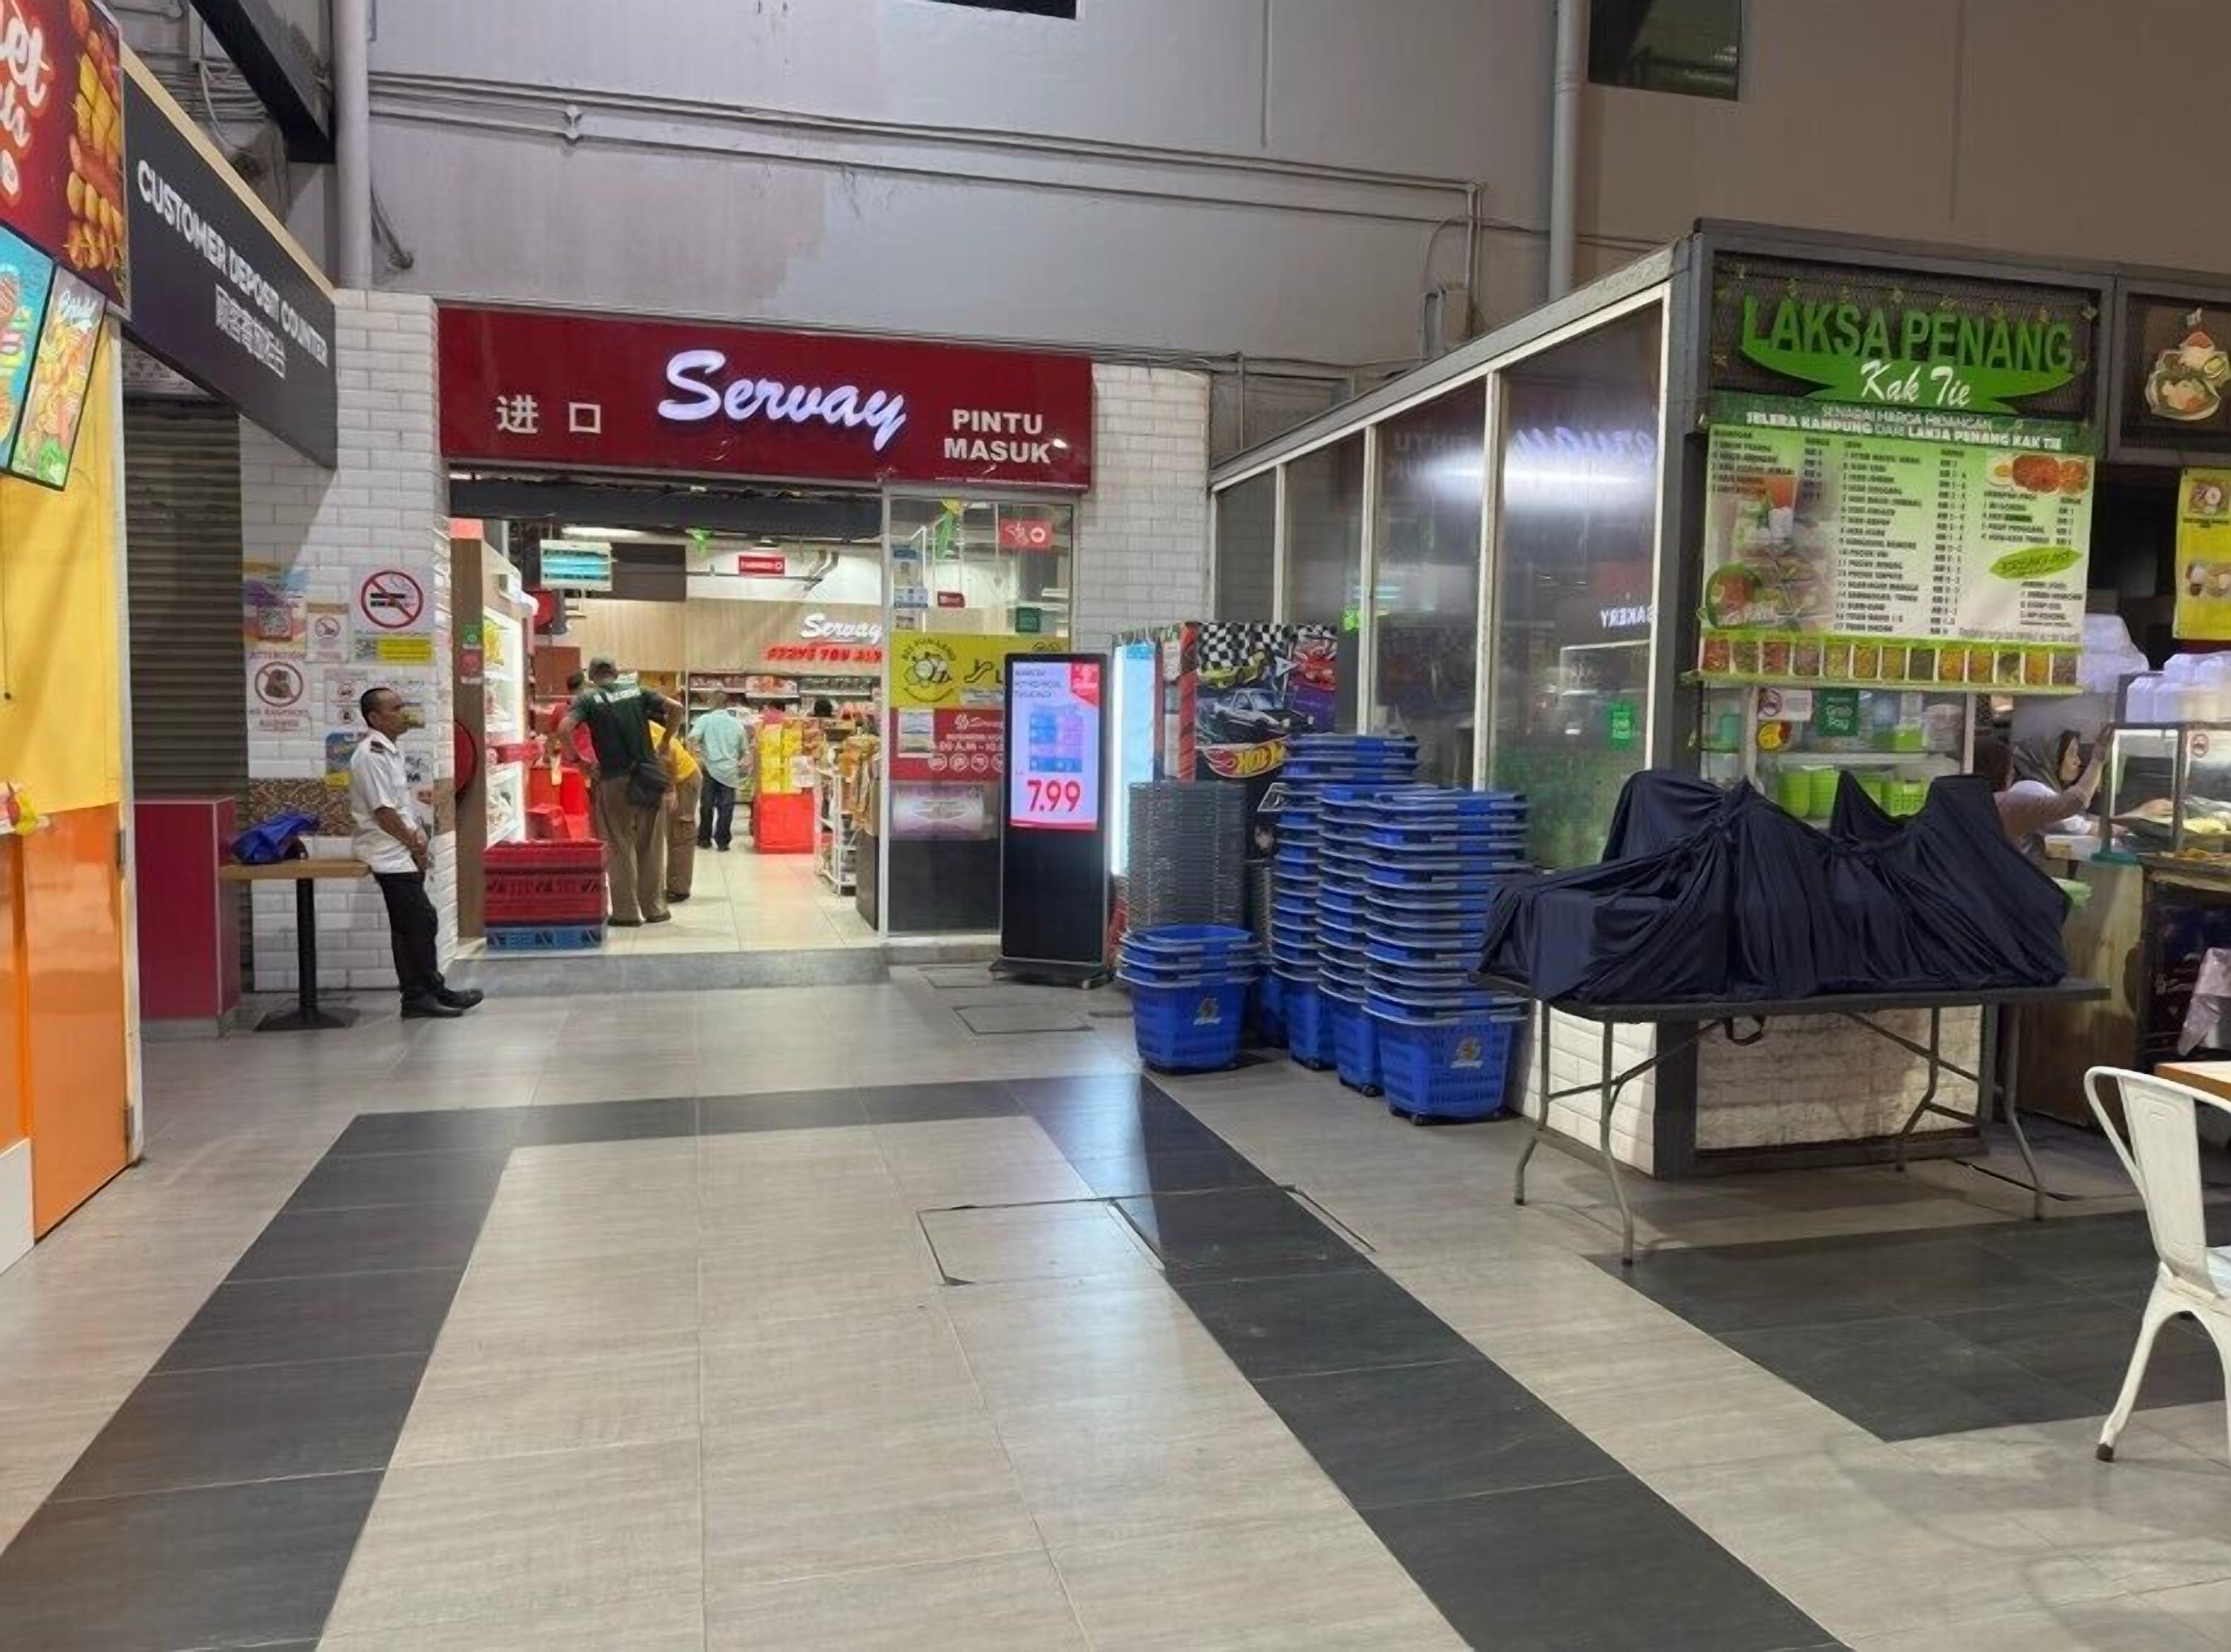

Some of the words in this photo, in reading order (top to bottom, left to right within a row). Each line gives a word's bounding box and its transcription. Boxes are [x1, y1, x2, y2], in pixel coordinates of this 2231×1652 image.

[138, 159, 228, 276] CUSTOMER
[1742, 294, 1892, 360] LAKSA
[1900, 308, 2073, 372] PENANG
[658, 349, 907, 452] Servay
[1860, 359, 1919, 403] Kak
[1930, 365, 1971, 406] Tie
[496, 394, 601, 435] 进口
[952, 408, 1044, 435] PINTU
[943, 438, 1051, 464] MASUK
[1027, 780, 1082, 813] 7.99
